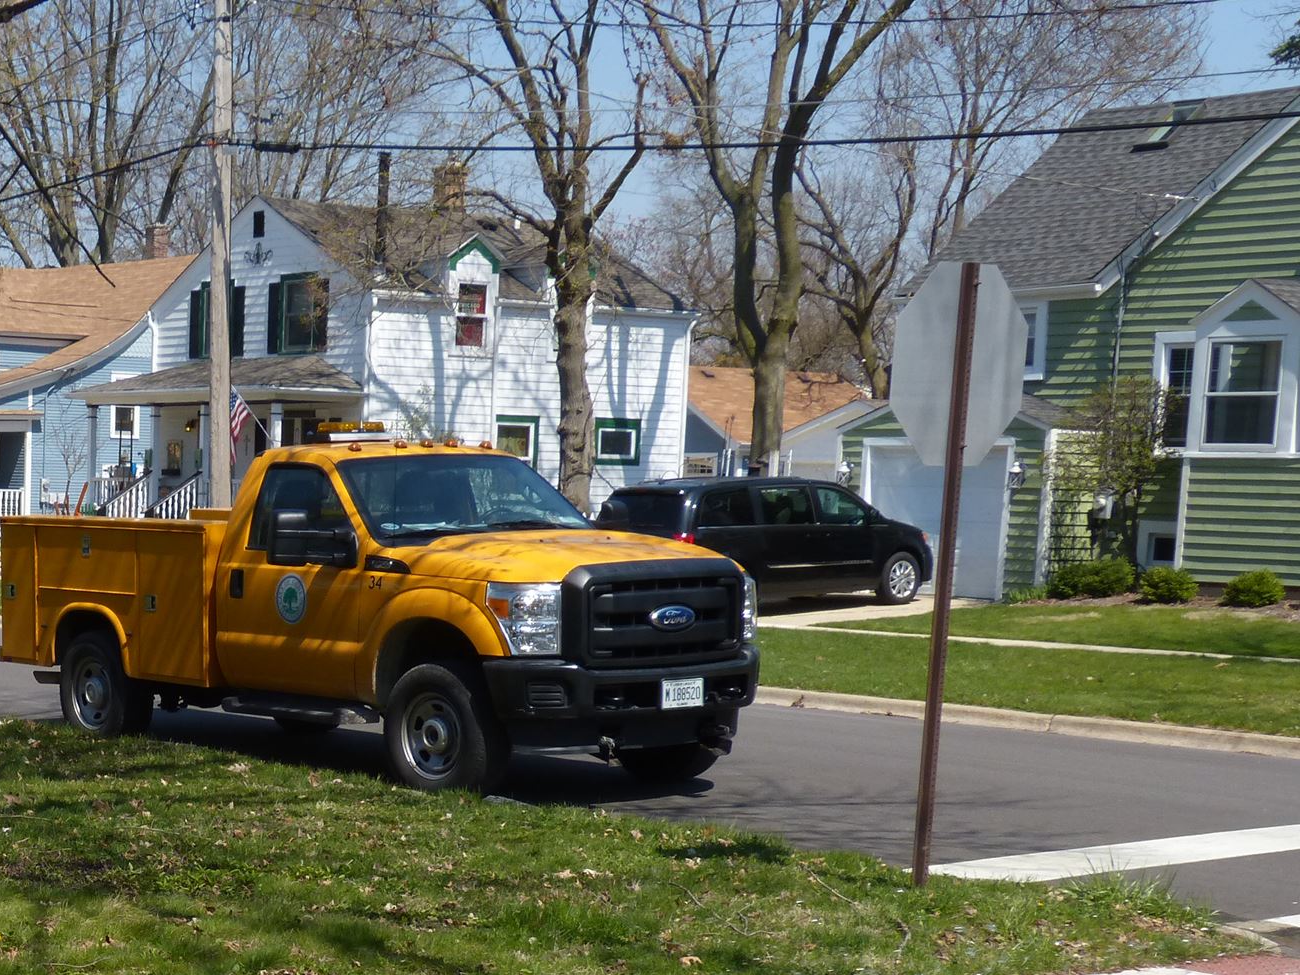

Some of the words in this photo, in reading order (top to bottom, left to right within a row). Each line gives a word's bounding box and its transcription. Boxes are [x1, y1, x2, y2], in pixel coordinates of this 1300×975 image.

[368, 575, 383, 590] 34
[663, 610, 688, 624] Ford
[672, 686, 701, 702] 188520
